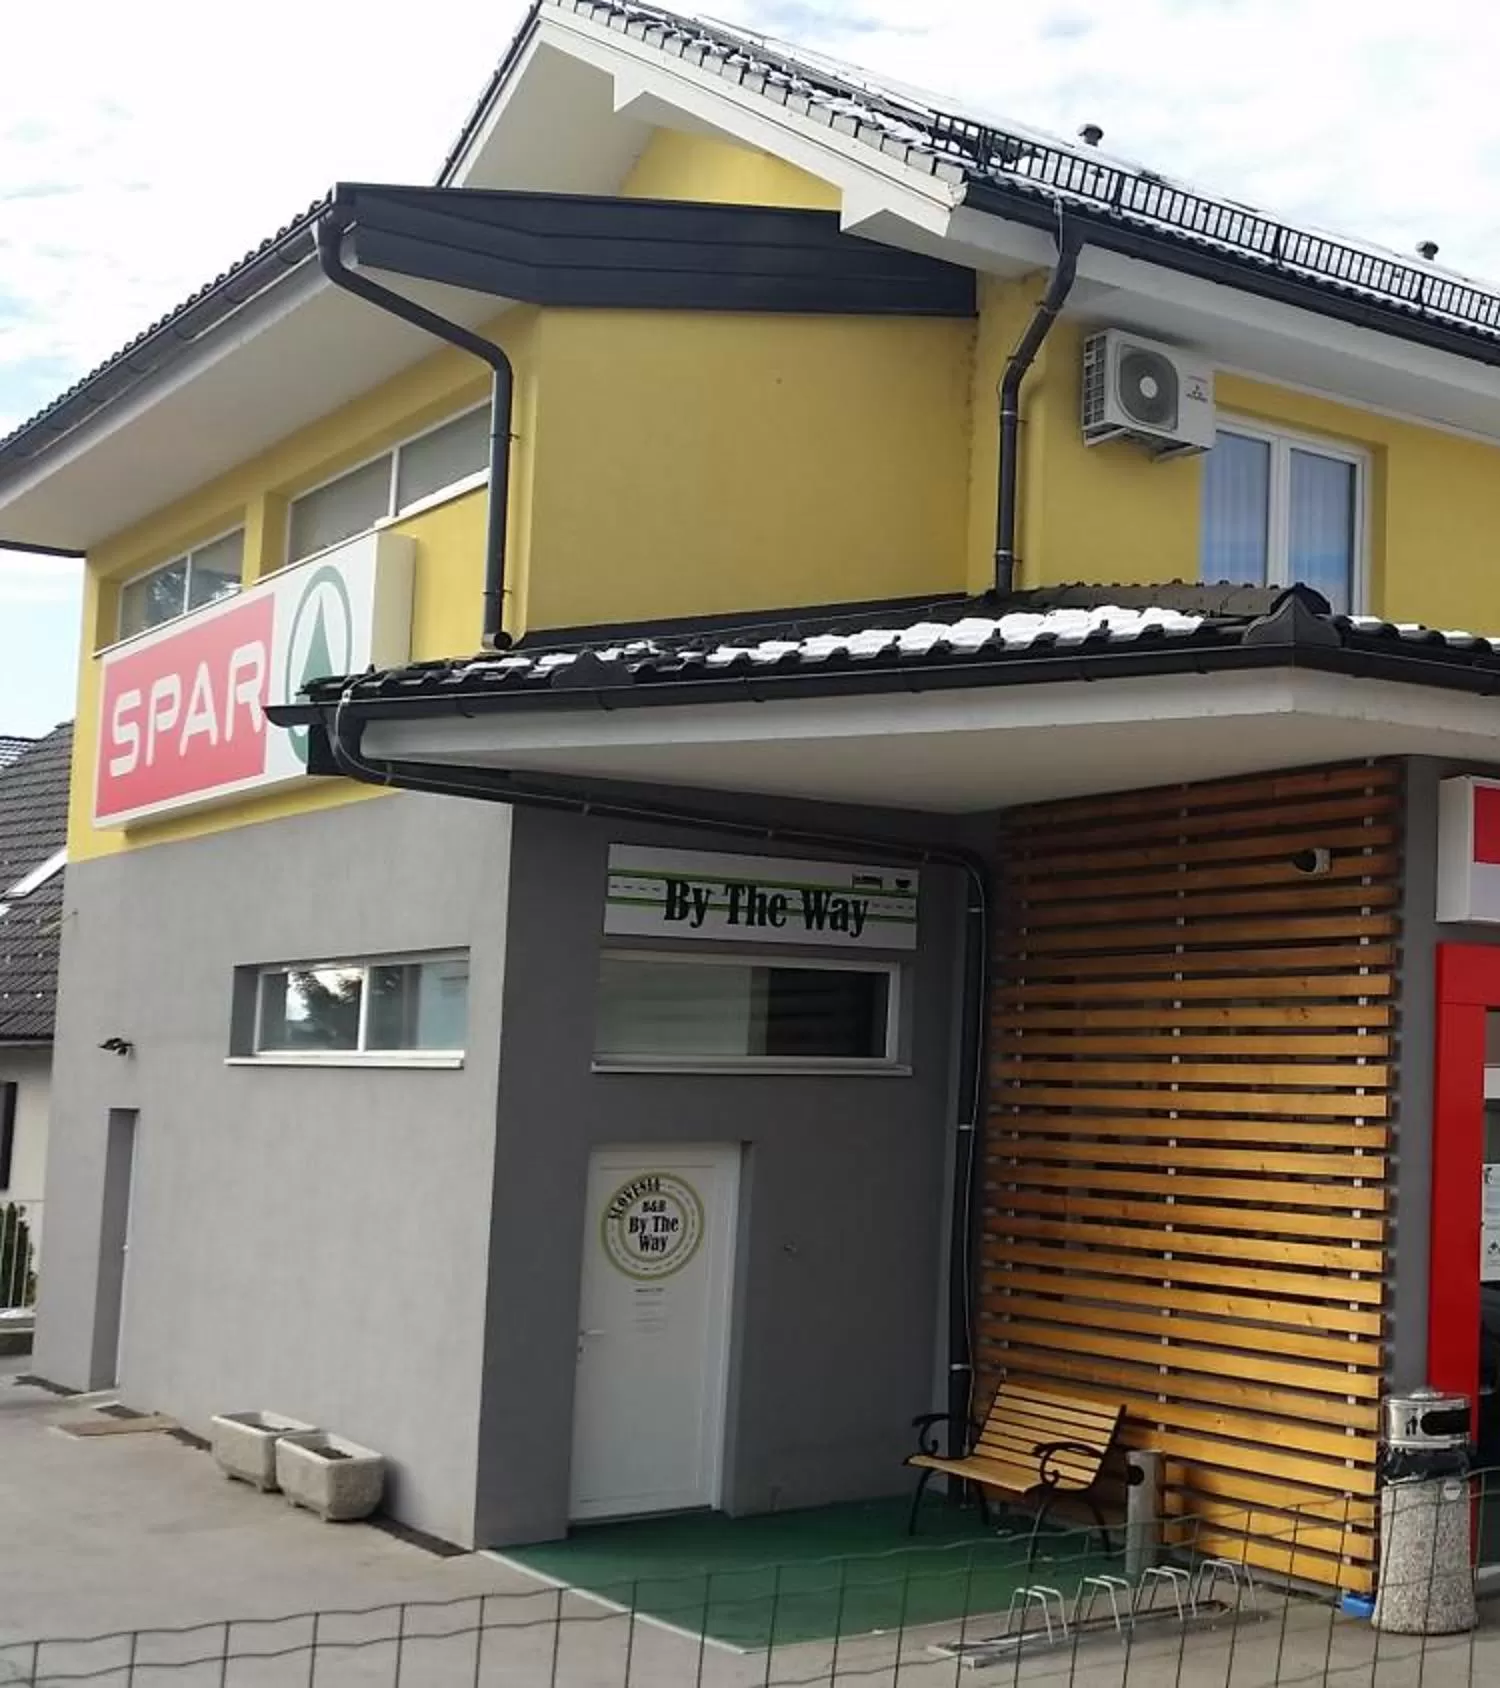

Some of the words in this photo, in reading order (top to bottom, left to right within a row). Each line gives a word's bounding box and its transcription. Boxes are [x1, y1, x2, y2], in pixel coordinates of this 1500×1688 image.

[108, 638, 269, 778] SPAR
[664, 878, 715, 929] By
[724, 883, 788, 928] The
[800, 889, 869, 938] Way
[628, 1216, 649, 1237] By
[652, 1215, 679, 1233] The
[638, 1233, 669, 1254] Way
